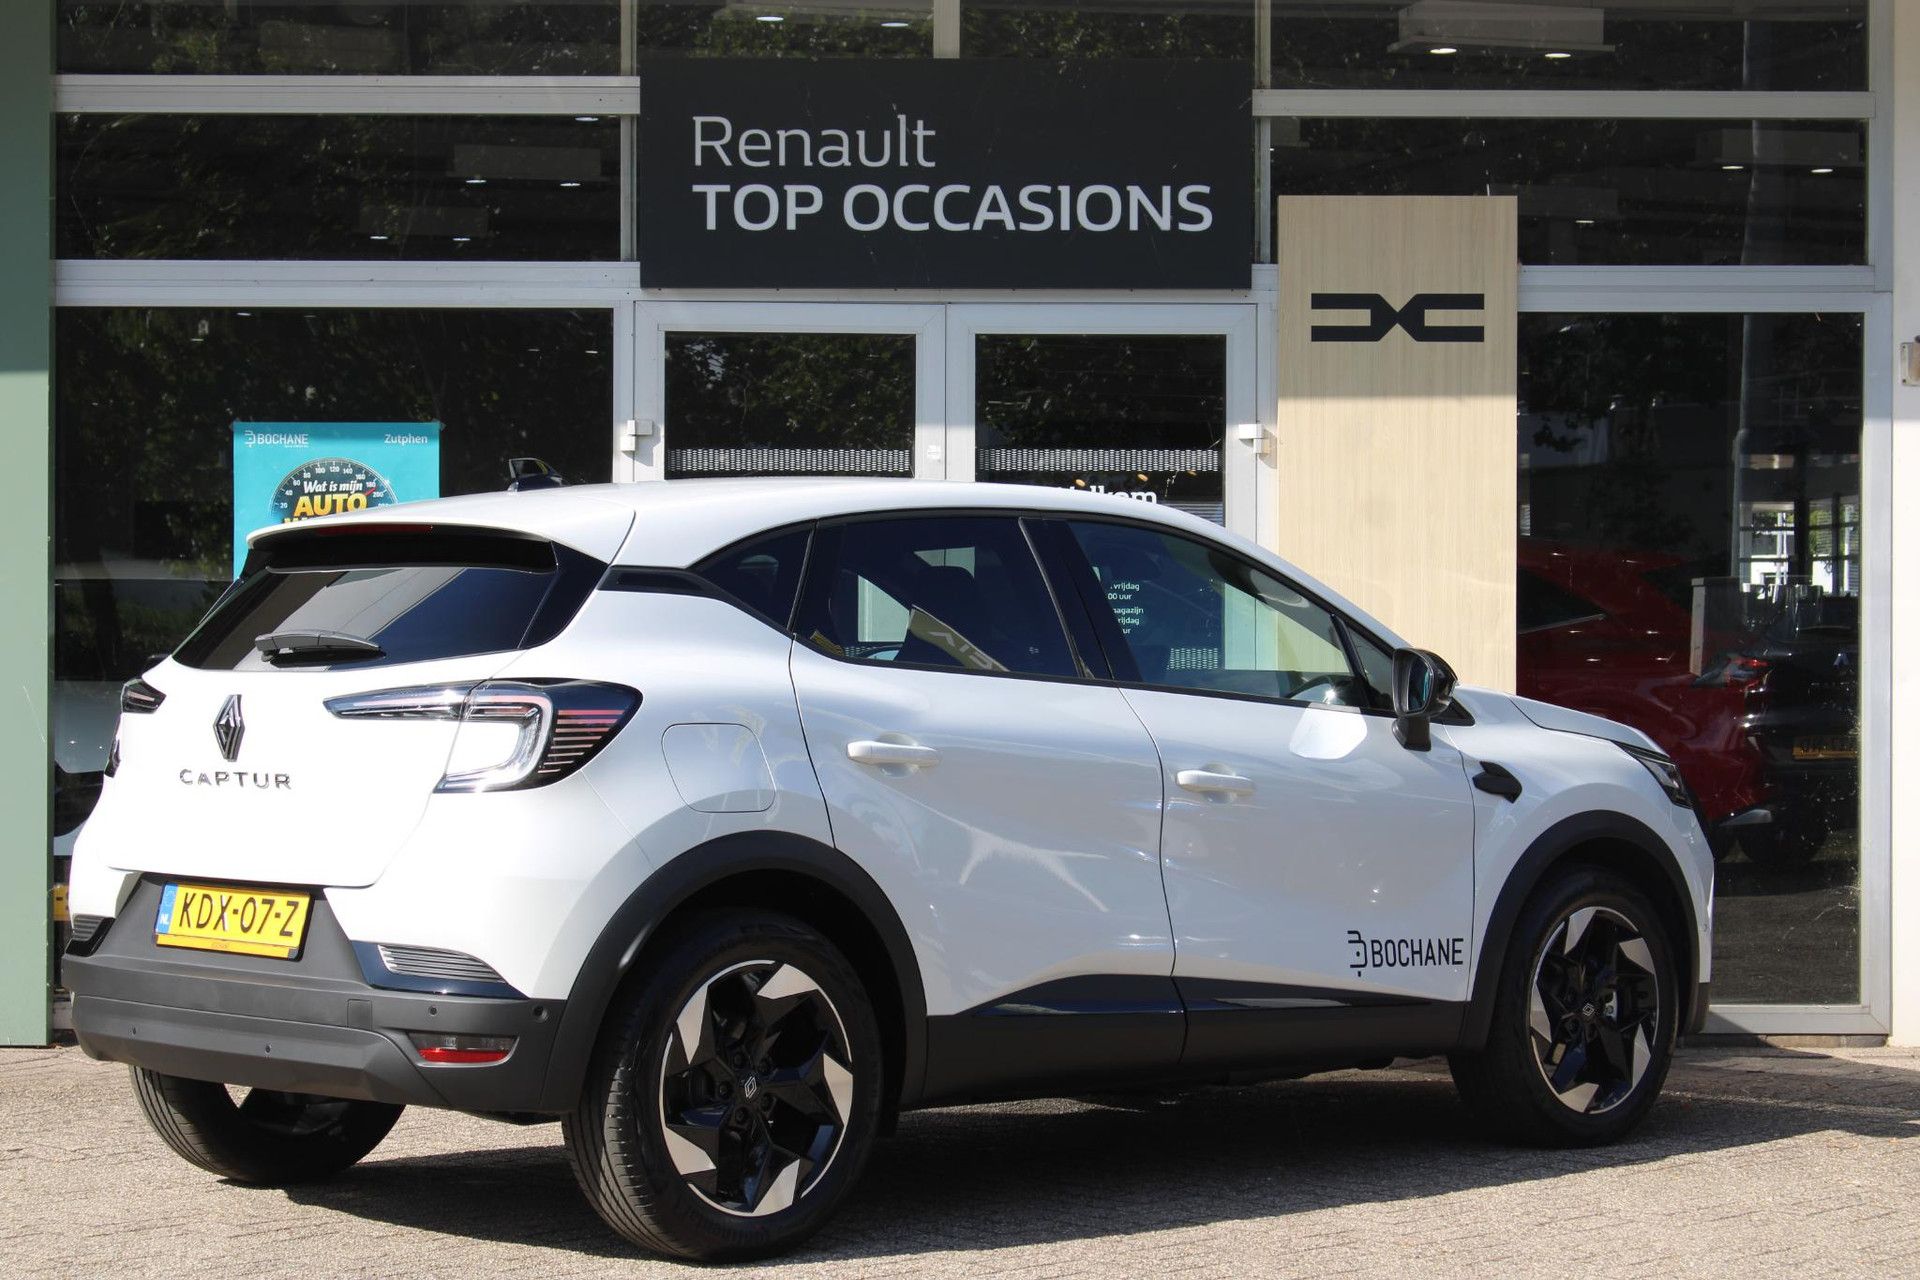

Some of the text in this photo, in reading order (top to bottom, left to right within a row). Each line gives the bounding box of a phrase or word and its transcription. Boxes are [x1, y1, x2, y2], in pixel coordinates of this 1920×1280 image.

[691, 113, 936, 168] Renault
[692, 183, 1213, 232] TOP OCCASIONS
[257, 433, 309, 445] BOCHANE
[384, 433, 428, 446] Zutphen
[303, 480, 363, 494] Wat is mijn
[293, 493, 367, 517] AUTO
[1113, 582, 1140, 591] vrijdag
[1117, 617, 1140, 625] rijdag
[179, 768, 292, 790] CAPTUR
[178, 891, 300, 938] KDX-07-Z
[1370, 938, 1464, 968] BOCHANE
